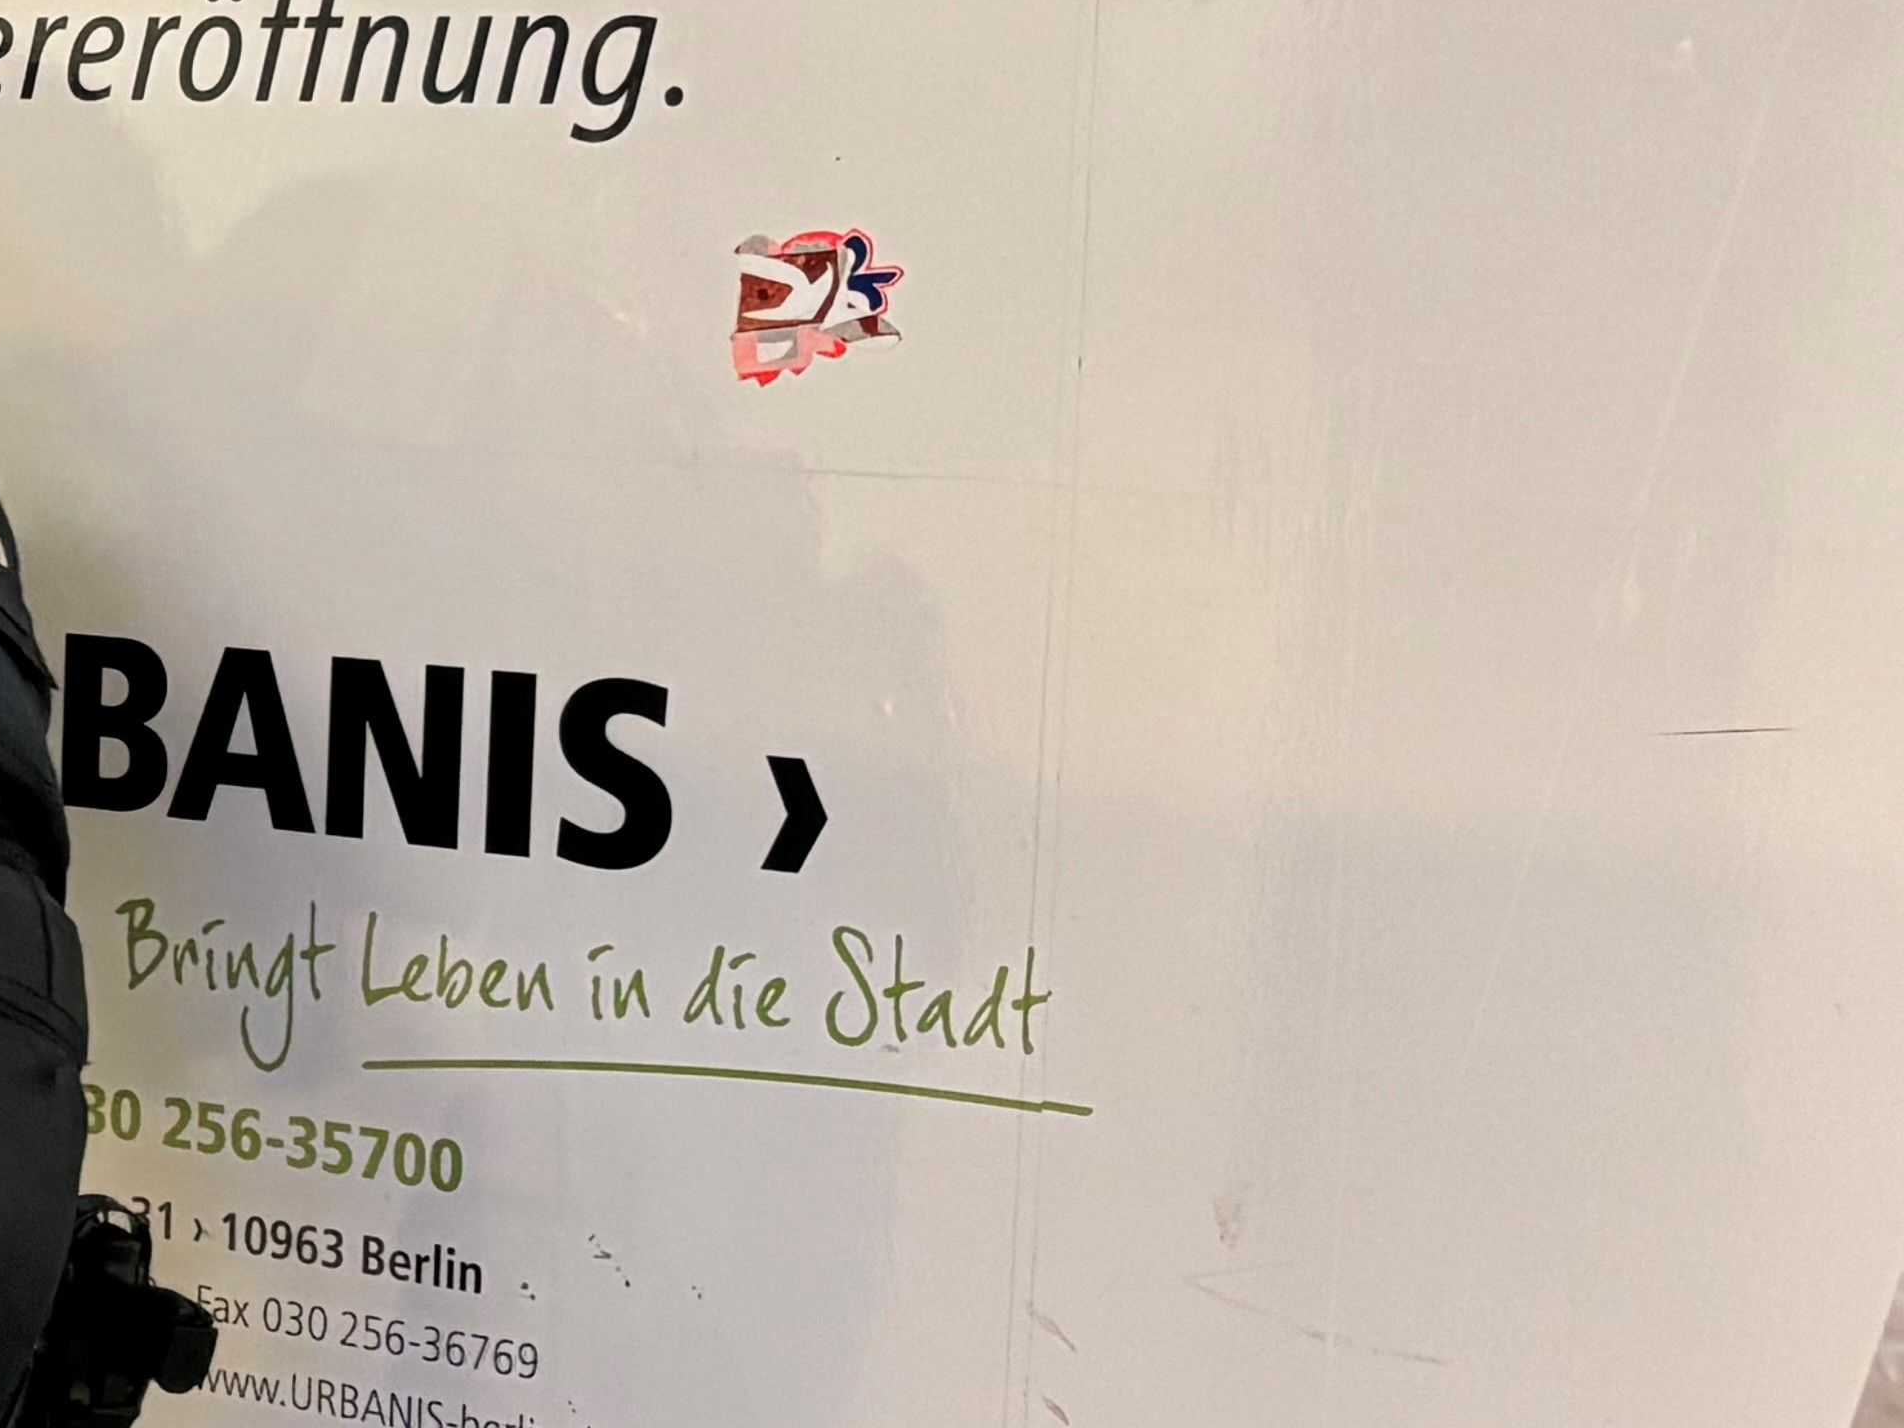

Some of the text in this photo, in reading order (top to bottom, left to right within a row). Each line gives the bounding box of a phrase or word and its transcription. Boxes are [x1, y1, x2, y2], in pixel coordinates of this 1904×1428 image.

[62, 632, 672, 871] BANIS
[117, 899, 1052, 1071] Bringt Leben in die Stadt
[83, 1083, 463, 1193] 30 256-35700
[222, 1212, 344, 1269] 10963
[361, 1235, 483, 1295] Berlin
[198, 1284, 539, 1380] Fax 030 256-36769
